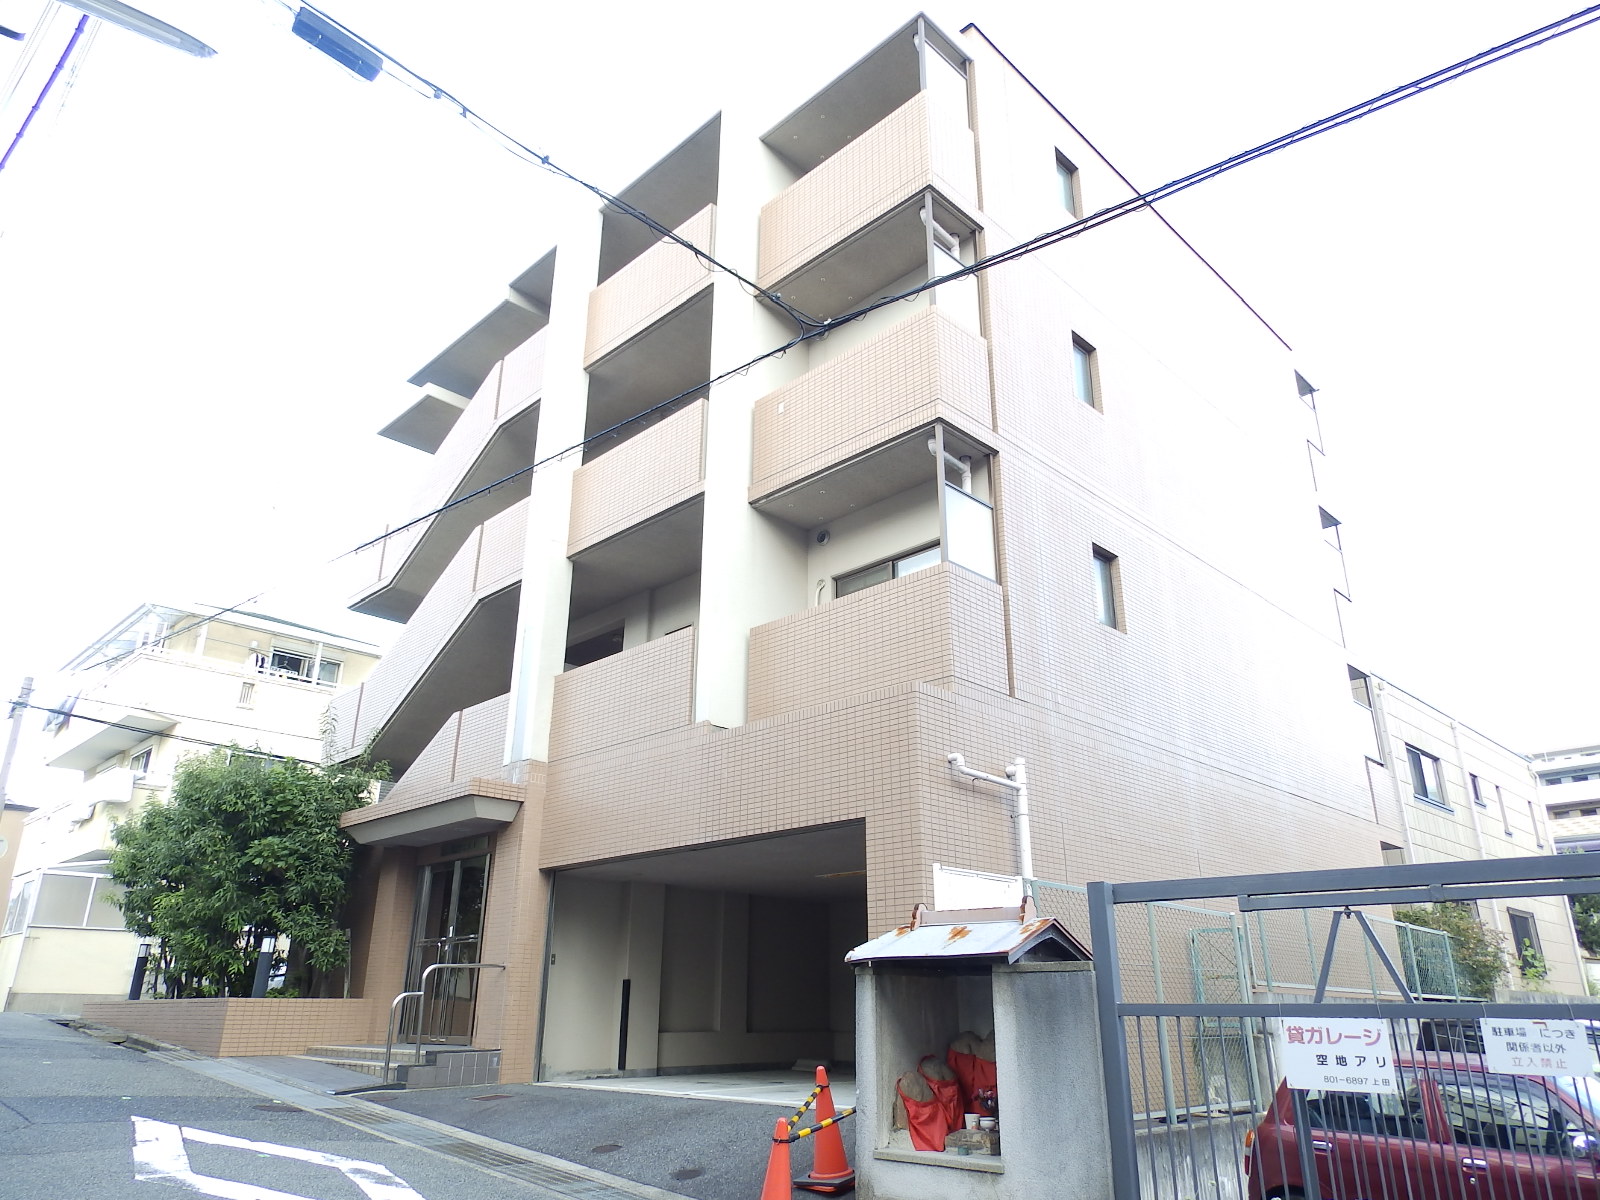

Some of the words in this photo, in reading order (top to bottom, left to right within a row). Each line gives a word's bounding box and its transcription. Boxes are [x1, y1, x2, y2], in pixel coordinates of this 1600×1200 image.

[1286, 1025, 1381, 1046] 貸ガレージ
[1539, 1028, 1576, 1039] につき
[1506, 1041, 1567, 1054] 関係者以外
[1316, 1054, 1386, 1068] 空地アリ
[1511, 1057, 1568, 1069] 立入禁止
[1323, 1075, 1369, 1085] 801-6897
[1372, 1078, 1390, 1087] 上田
